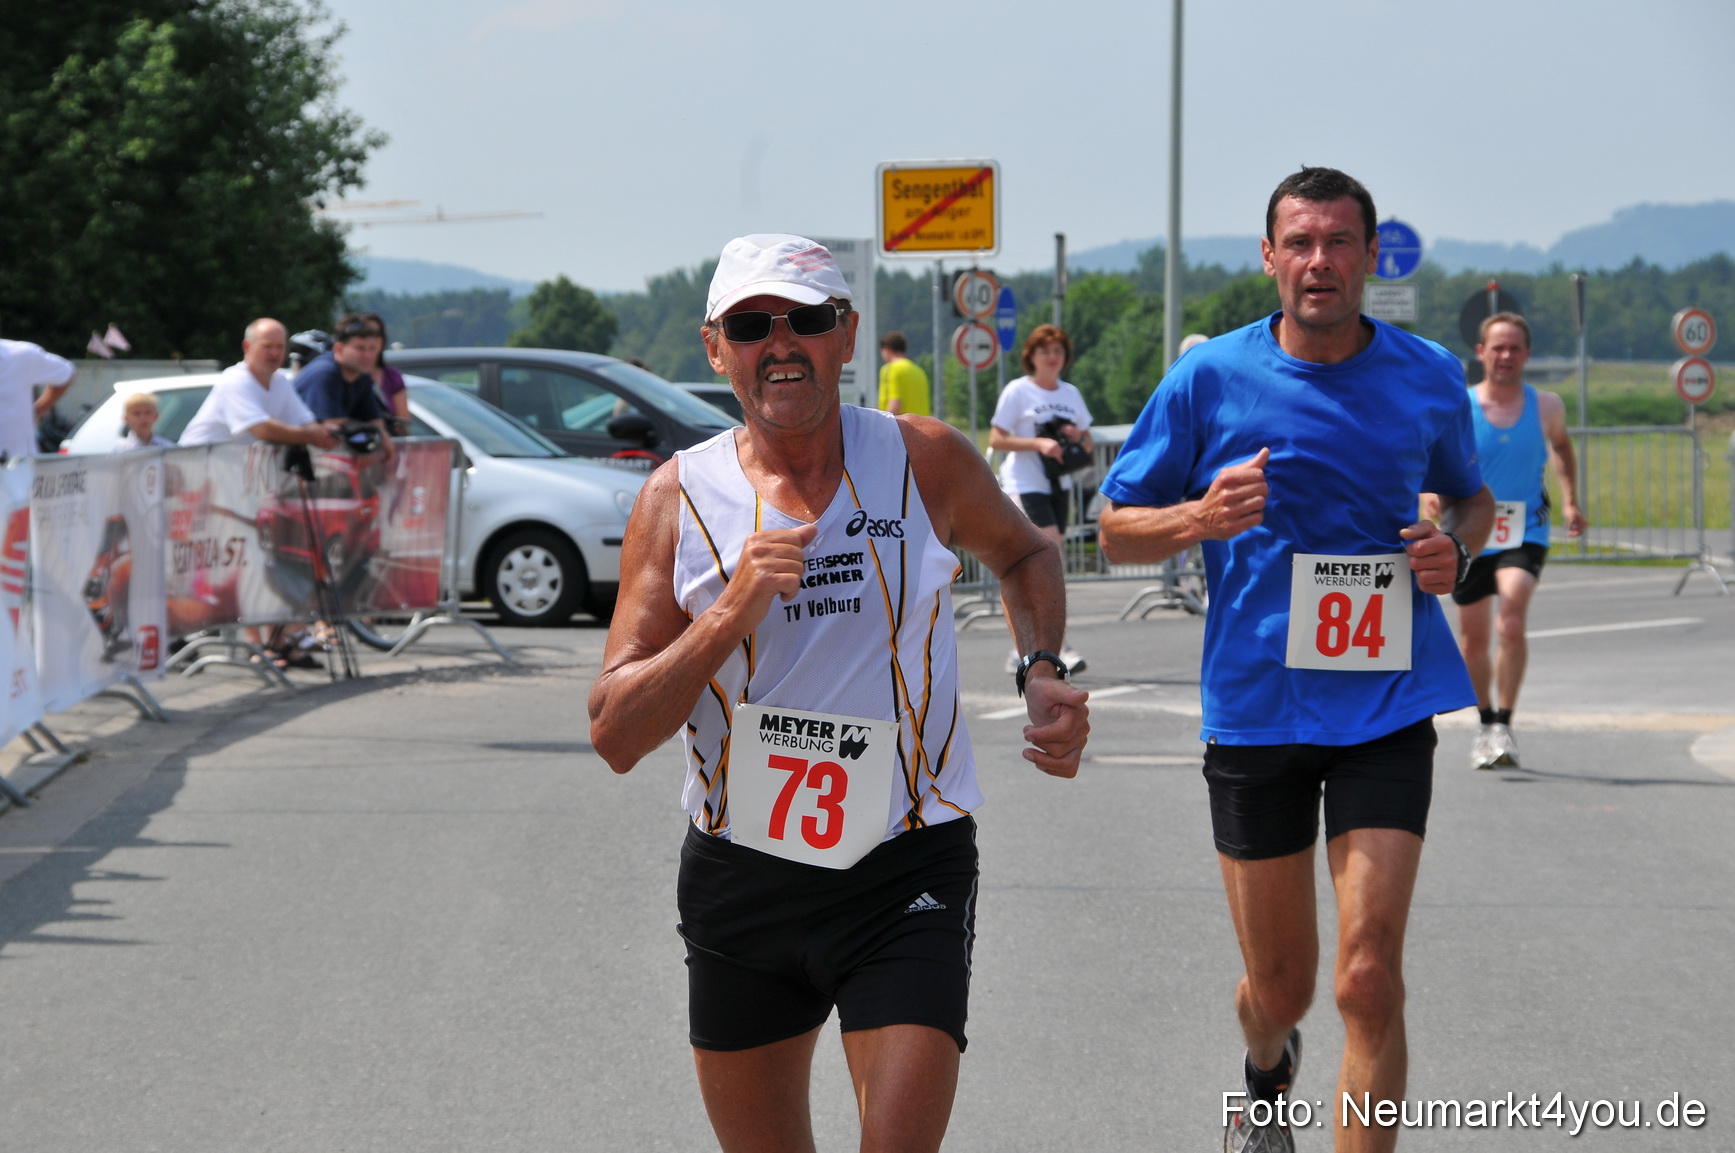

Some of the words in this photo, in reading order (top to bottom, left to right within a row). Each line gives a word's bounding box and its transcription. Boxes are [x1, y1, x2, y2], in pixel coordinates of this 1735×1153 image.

[892, 176, 984, 205] Sengenthal
[1686, 321, 1708, 342] 60
[866, 518, 905, 539] asics
[222, 536, 248, 568] ST.
[802, 551, 865, 573] TERSPORT
[799, 568, 865, 590] ACKNER
[1314, 562, 1372, 577] MEYER
[1314, 576, 1372, 587] WERBUNG
[783, 603, 801, 623] TV
[807, 597, 861, 618] Velburg
[1315, 591, 1386, 659] 84
[759, 713, 835, 740] MEYER
[759, 731, 834, 753] WERBUNG
[767, 753, 849, 850] 73
[904, 904, 947, 913] adidas
